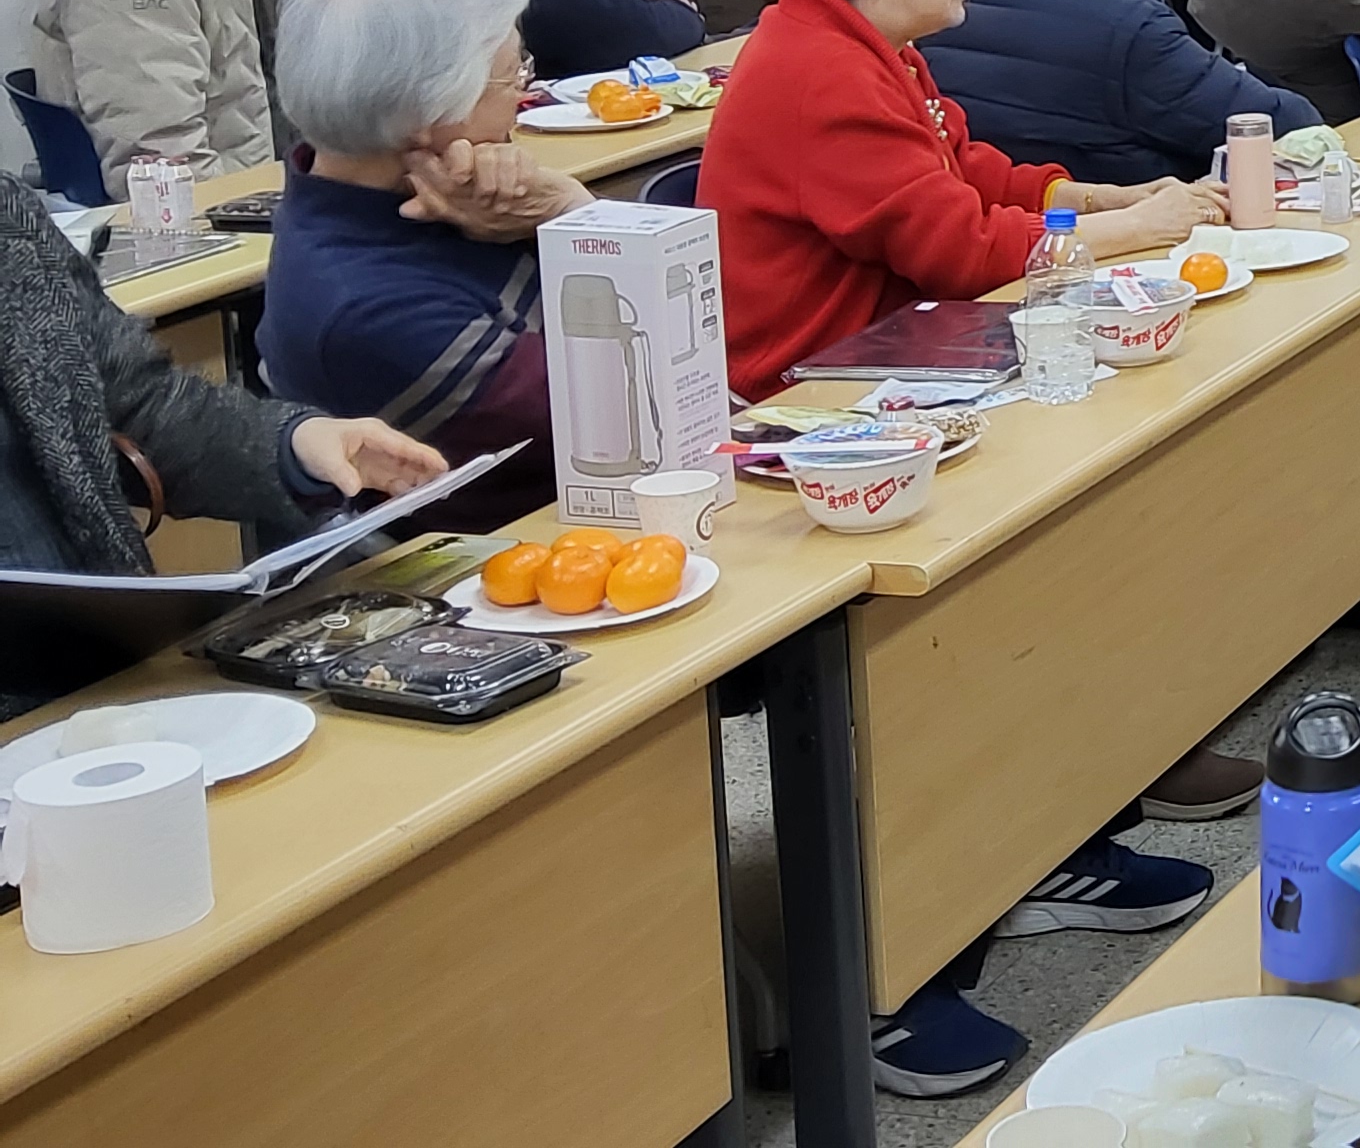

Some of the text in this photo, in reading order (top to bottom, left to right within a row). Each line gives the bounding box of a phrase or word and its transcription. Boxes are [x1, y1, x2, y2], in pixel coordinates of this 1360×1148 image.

[571, 238, 622, 256] THERMOS
[584, 490, 597, 502] 1L
[827, 488, 860, 511] 육개장
